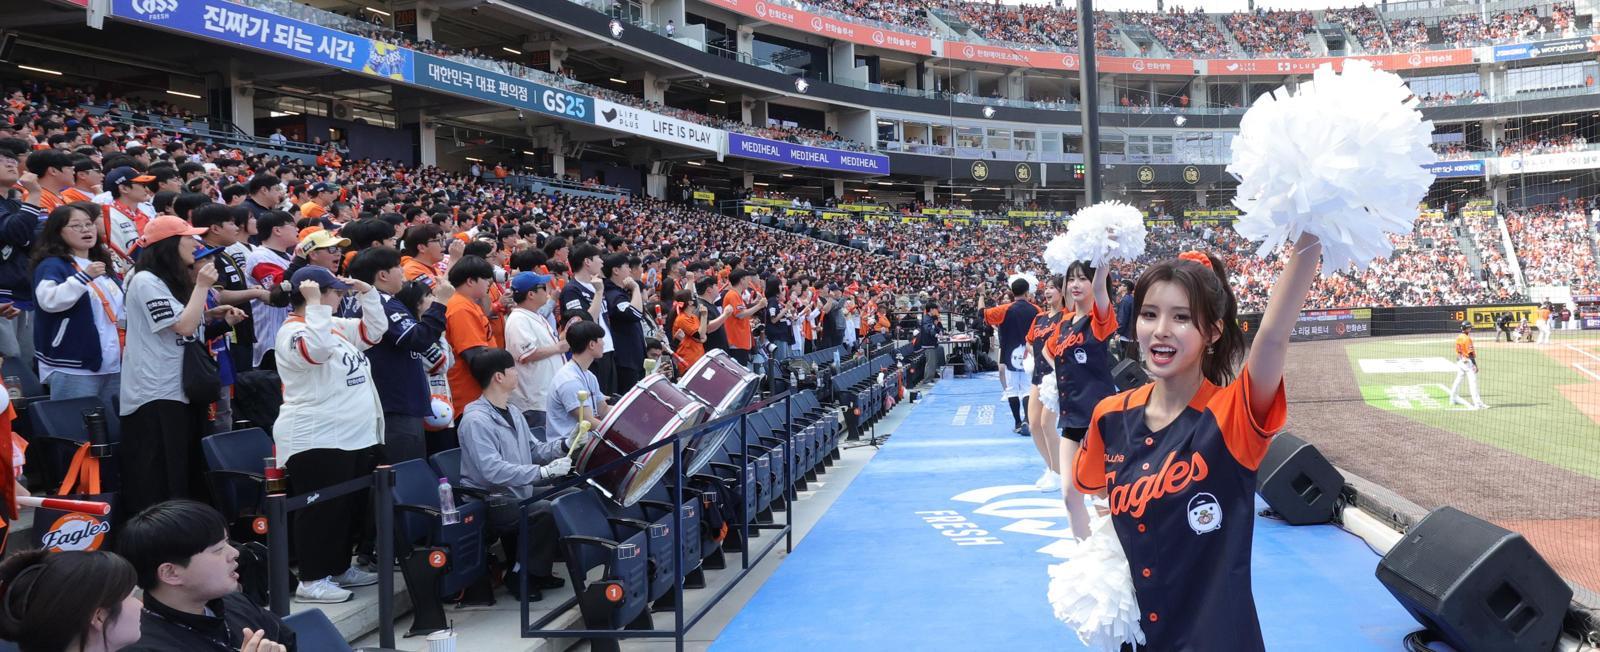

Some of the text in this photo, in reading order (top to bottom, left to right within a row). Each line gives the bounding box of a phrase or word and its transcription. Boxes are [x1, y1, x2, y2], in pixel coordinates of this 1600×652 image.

[203, 5, 355, 63] 진짜가 되는 시간
[428, 63, 528, 102] 대한민국 대표 편의점
[543, 90, 585, 118] GS25
[620, 109, 639, 120] LIFE
[620, 120, 639, 129] PLUS
[653, 119, 711, 144] LIFE IS PLAY
[742, 141, 781, 157] MEDIHEAL
[790, 149, 829, 163] MEDIHEAL
[841, 155, 878, 169] MEDIHEAL
[257, 521, 265, 530] 3
[915, 510, 1005, 546] FRESH
[42, 521, 110, 551] Eagles
[433, 554, 441, 564] 2
